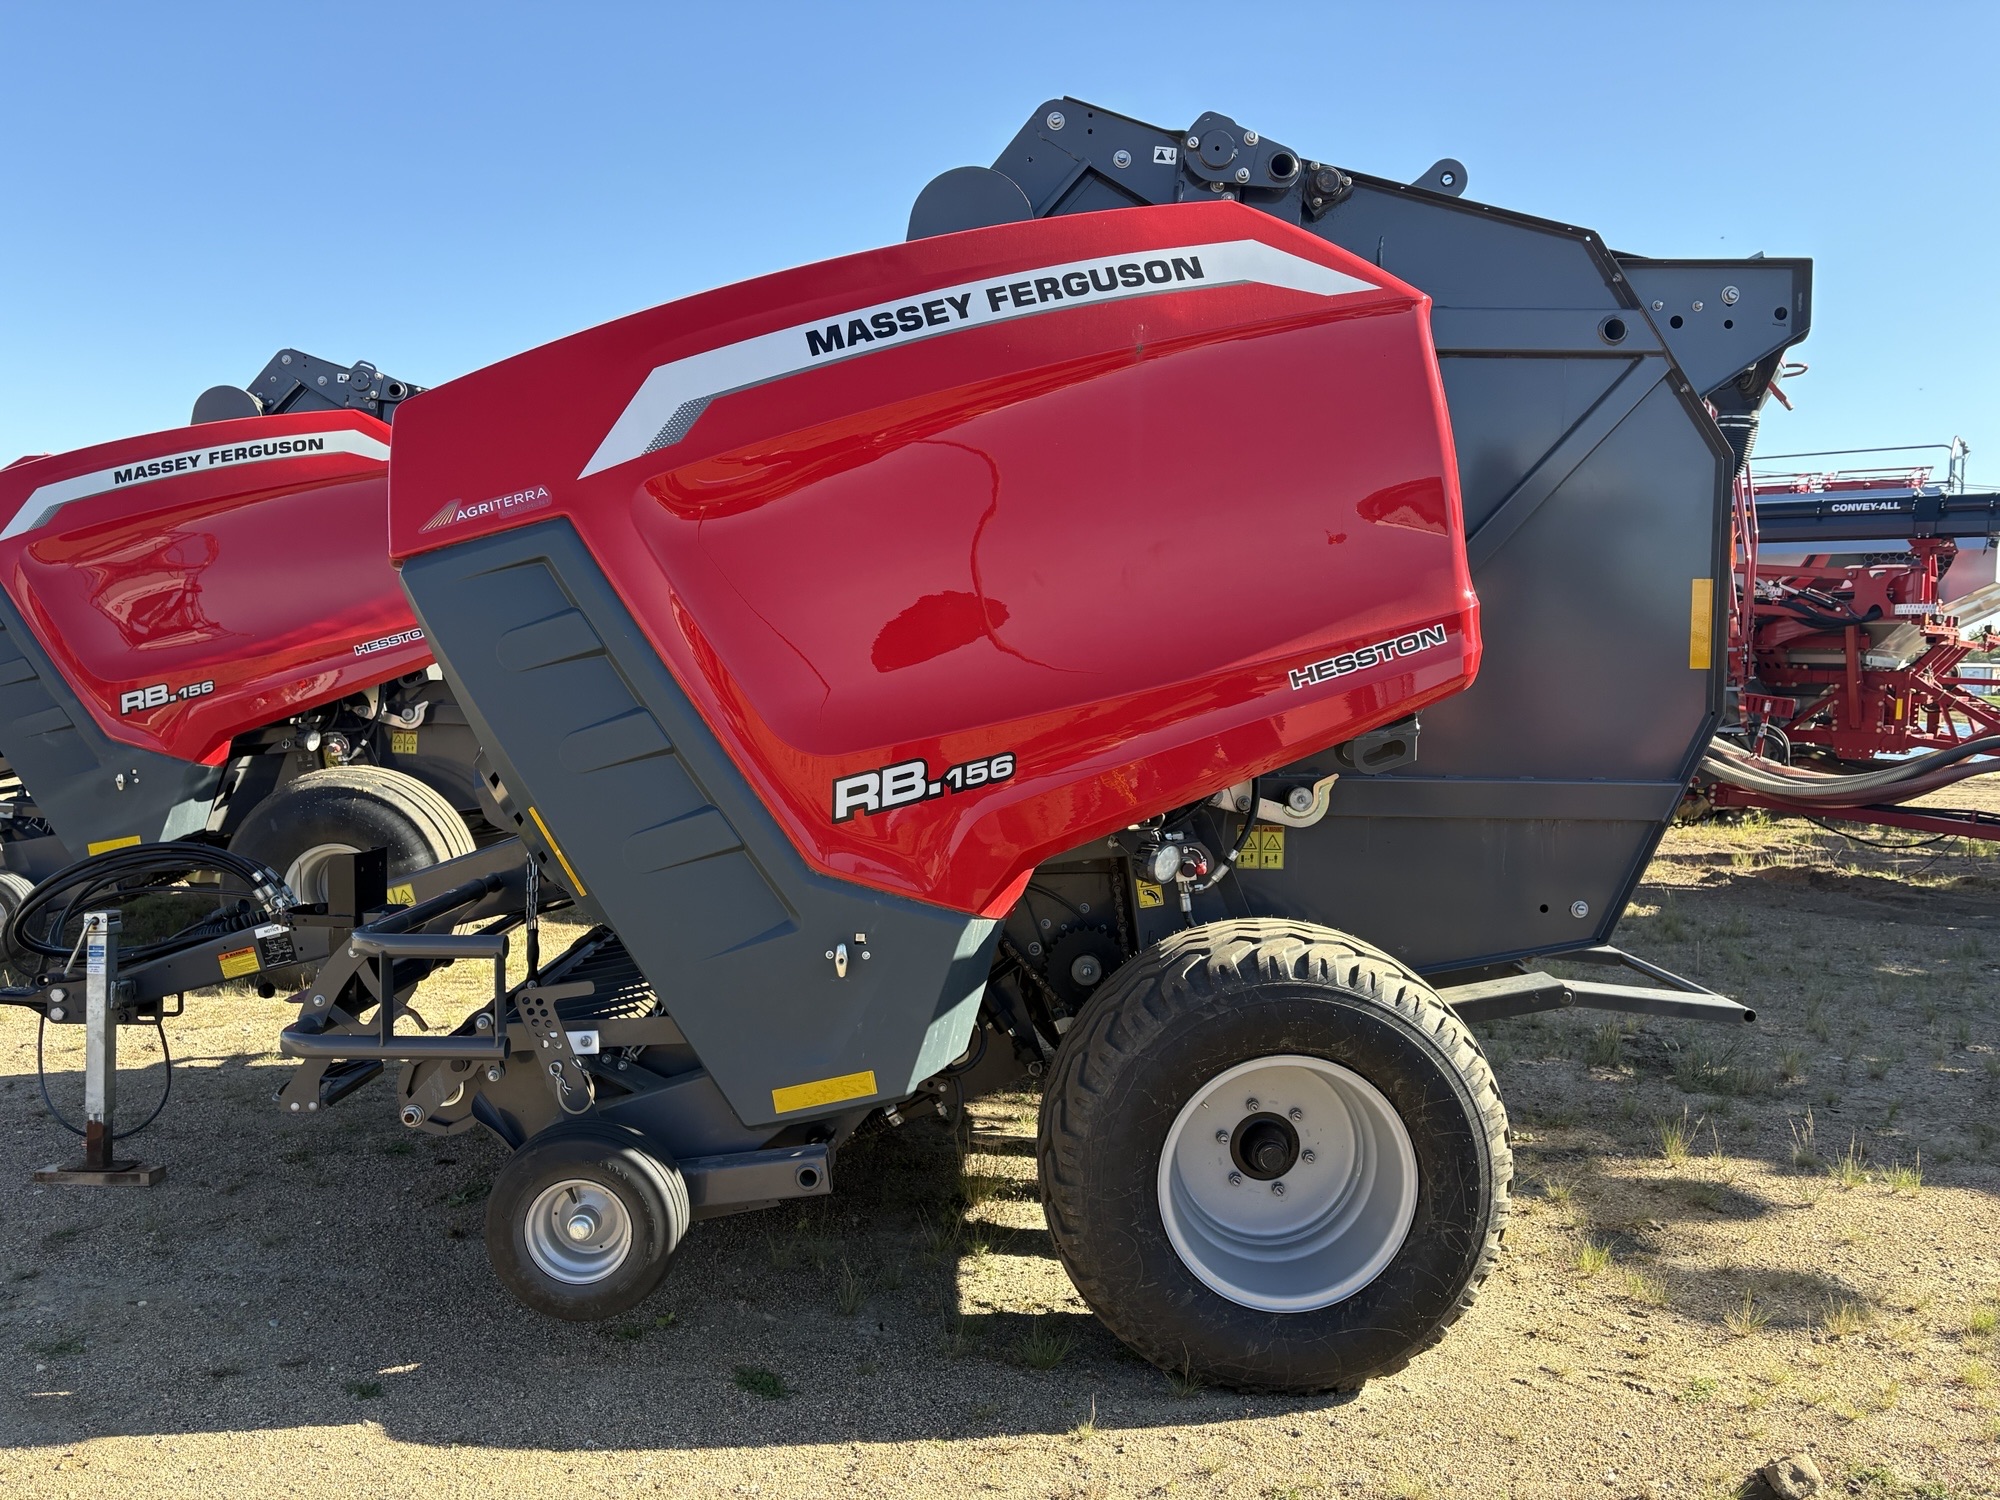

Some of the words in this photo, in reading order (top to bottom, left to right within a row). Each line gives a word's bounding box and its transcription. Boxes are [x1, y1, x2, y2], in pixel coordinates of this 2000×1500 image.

[805, 292, 972, 357] MASSEY
[985, 256, 1205, 312] FERGUSON
[114, 454, 202, 484] MASSEY
[208, 438, 324, 465] FERGUSON
[456, 487, 548, 521] AGRITERRA
[1831, 501, 1901, 512] CONVEY-ALL
[353, 628, 425, 656] HESSTO
[1289, 625, 1447, 689] HESSTON
[120, 680, 215, 715] RB.156
[833, 753, 1015, 821] RB.156
